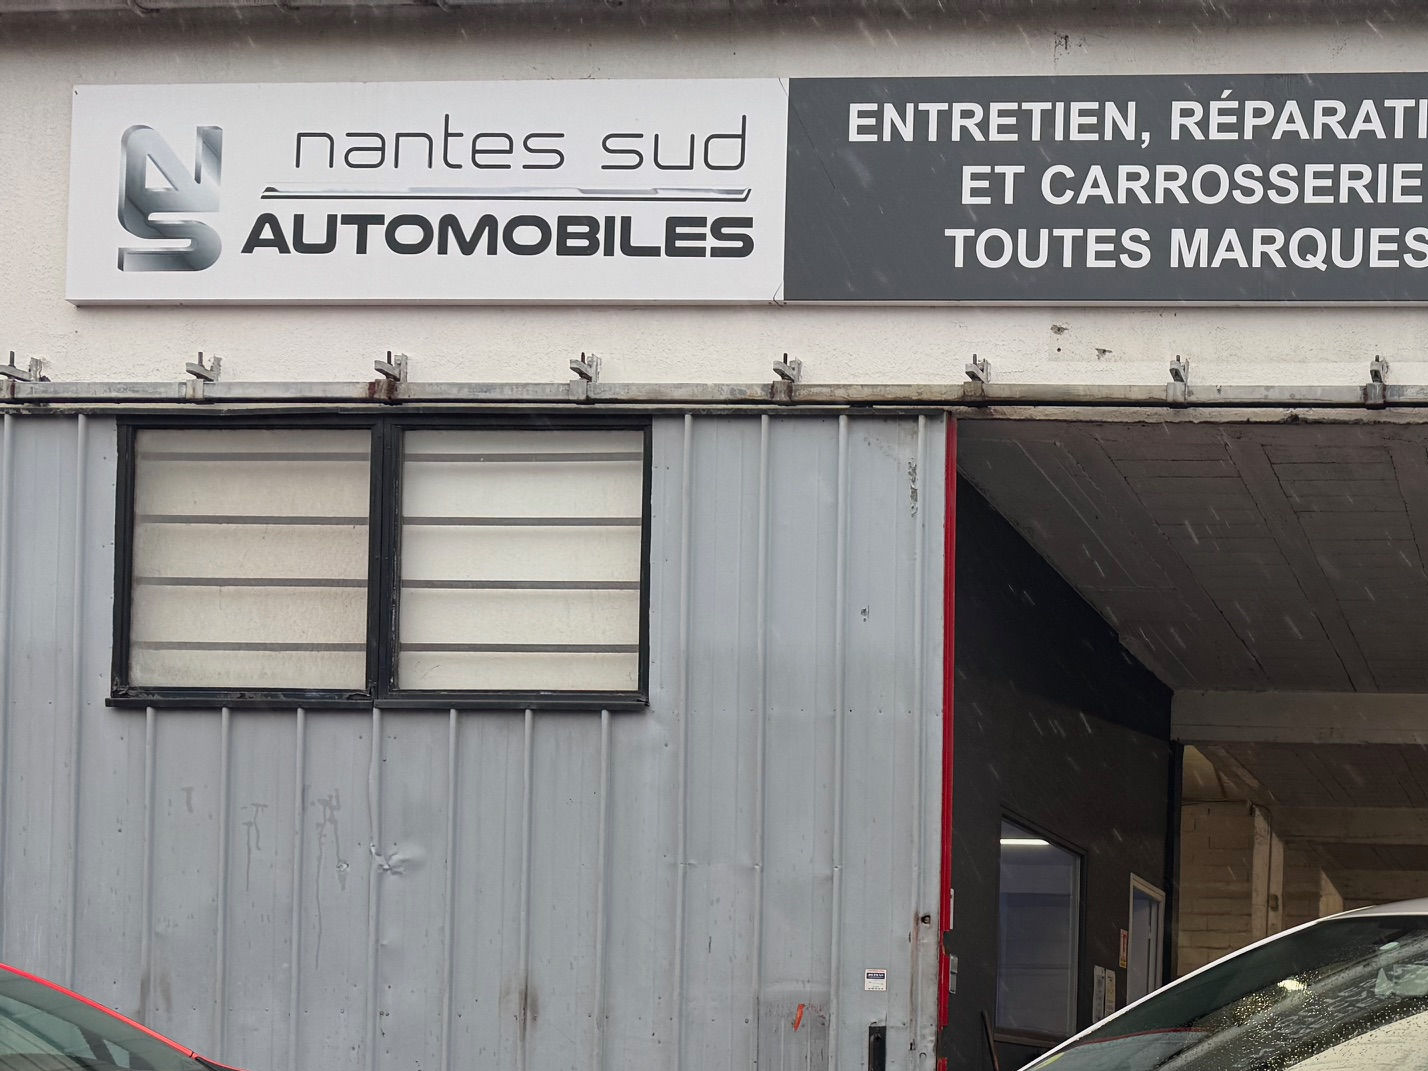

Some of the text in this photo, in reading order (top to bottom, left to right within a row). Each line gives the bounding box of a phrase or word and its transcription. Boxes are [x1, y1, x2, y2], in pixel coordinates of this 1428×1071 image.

[295, 113, 748, 171] nantes sud
[848, 101, 1151, 149] ENTRETIEN,
[961, 162, 1424, 206] ET CARROSSERIE
[240, 212, 756, 258] AUTOMOBILES
[944, 227, 1152, 269] TOUTES
